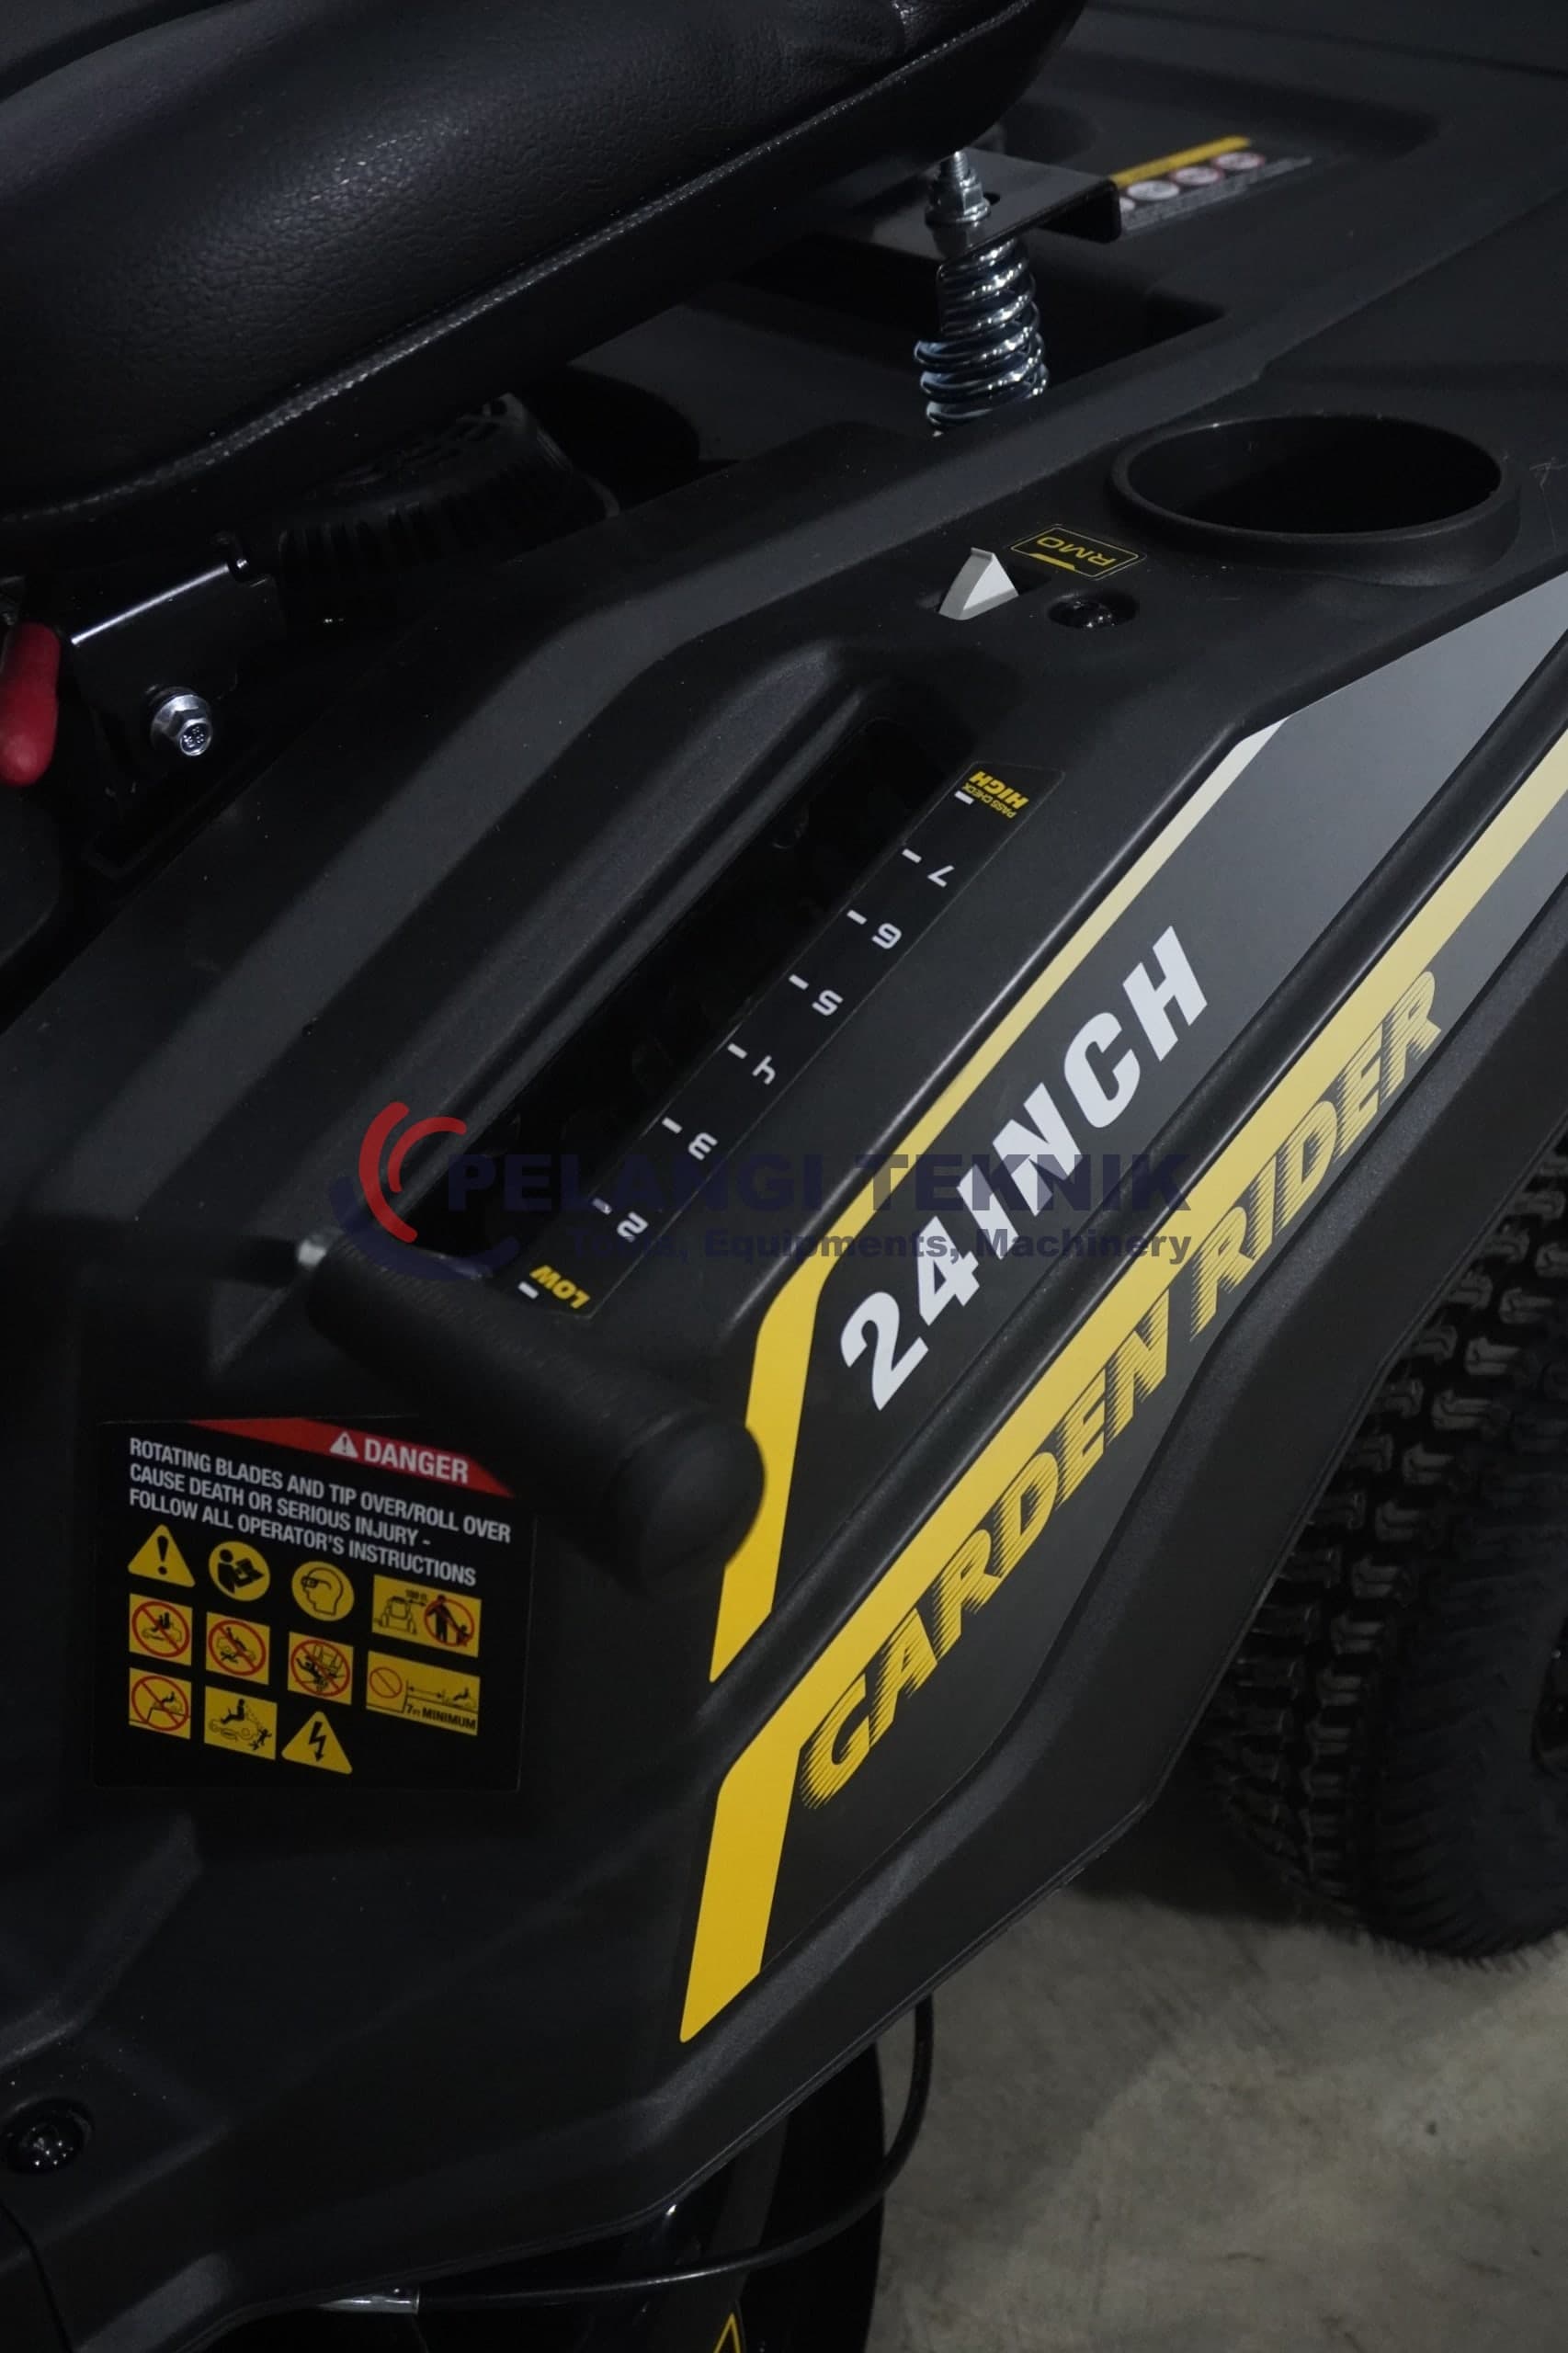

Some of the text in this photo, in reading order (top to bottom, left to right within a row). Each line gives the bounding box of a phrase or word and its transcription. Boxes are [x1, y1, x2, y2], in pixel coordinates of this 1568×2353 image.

[1036, 536, 1116, 567] RMO
[961, 783, 1017, 819] PASS CHECK
[968, 769, 1029, 810] HIGH
[927, 865, 955, 888] 7
[871, 923, 903, 949] 6
[812, 990, 843, 1017] 5
[752, 1055, 777, 1086] 4
[687, 1131, 718, 1161] 3
[617, 1211, 649, 1243] 2
[530, 1265, 590, 1310] LOW
[801, 971, 1441, 1810] GARDEN RIDER
[364, 1438, 470, 1484] DANGER
[129, 1438, 512, 1544] ROTATING BLADES AND TIP OVER/ROLL OVER
[129, 1463, 186, 1494] CAUSE
[189, 1477, 244, 1506] DEATH
[248, 1490, 273, 1513] OR
[277, 1496, 351, 1532] SERIOUS
[355, 1517, 419, 1549] INJURY
[129, 1488, 477, 1587] FOLLOW ALL OPERATOR'S INSTRUCTIONS
[422, 1707, 476, 1730] MINIMUM
